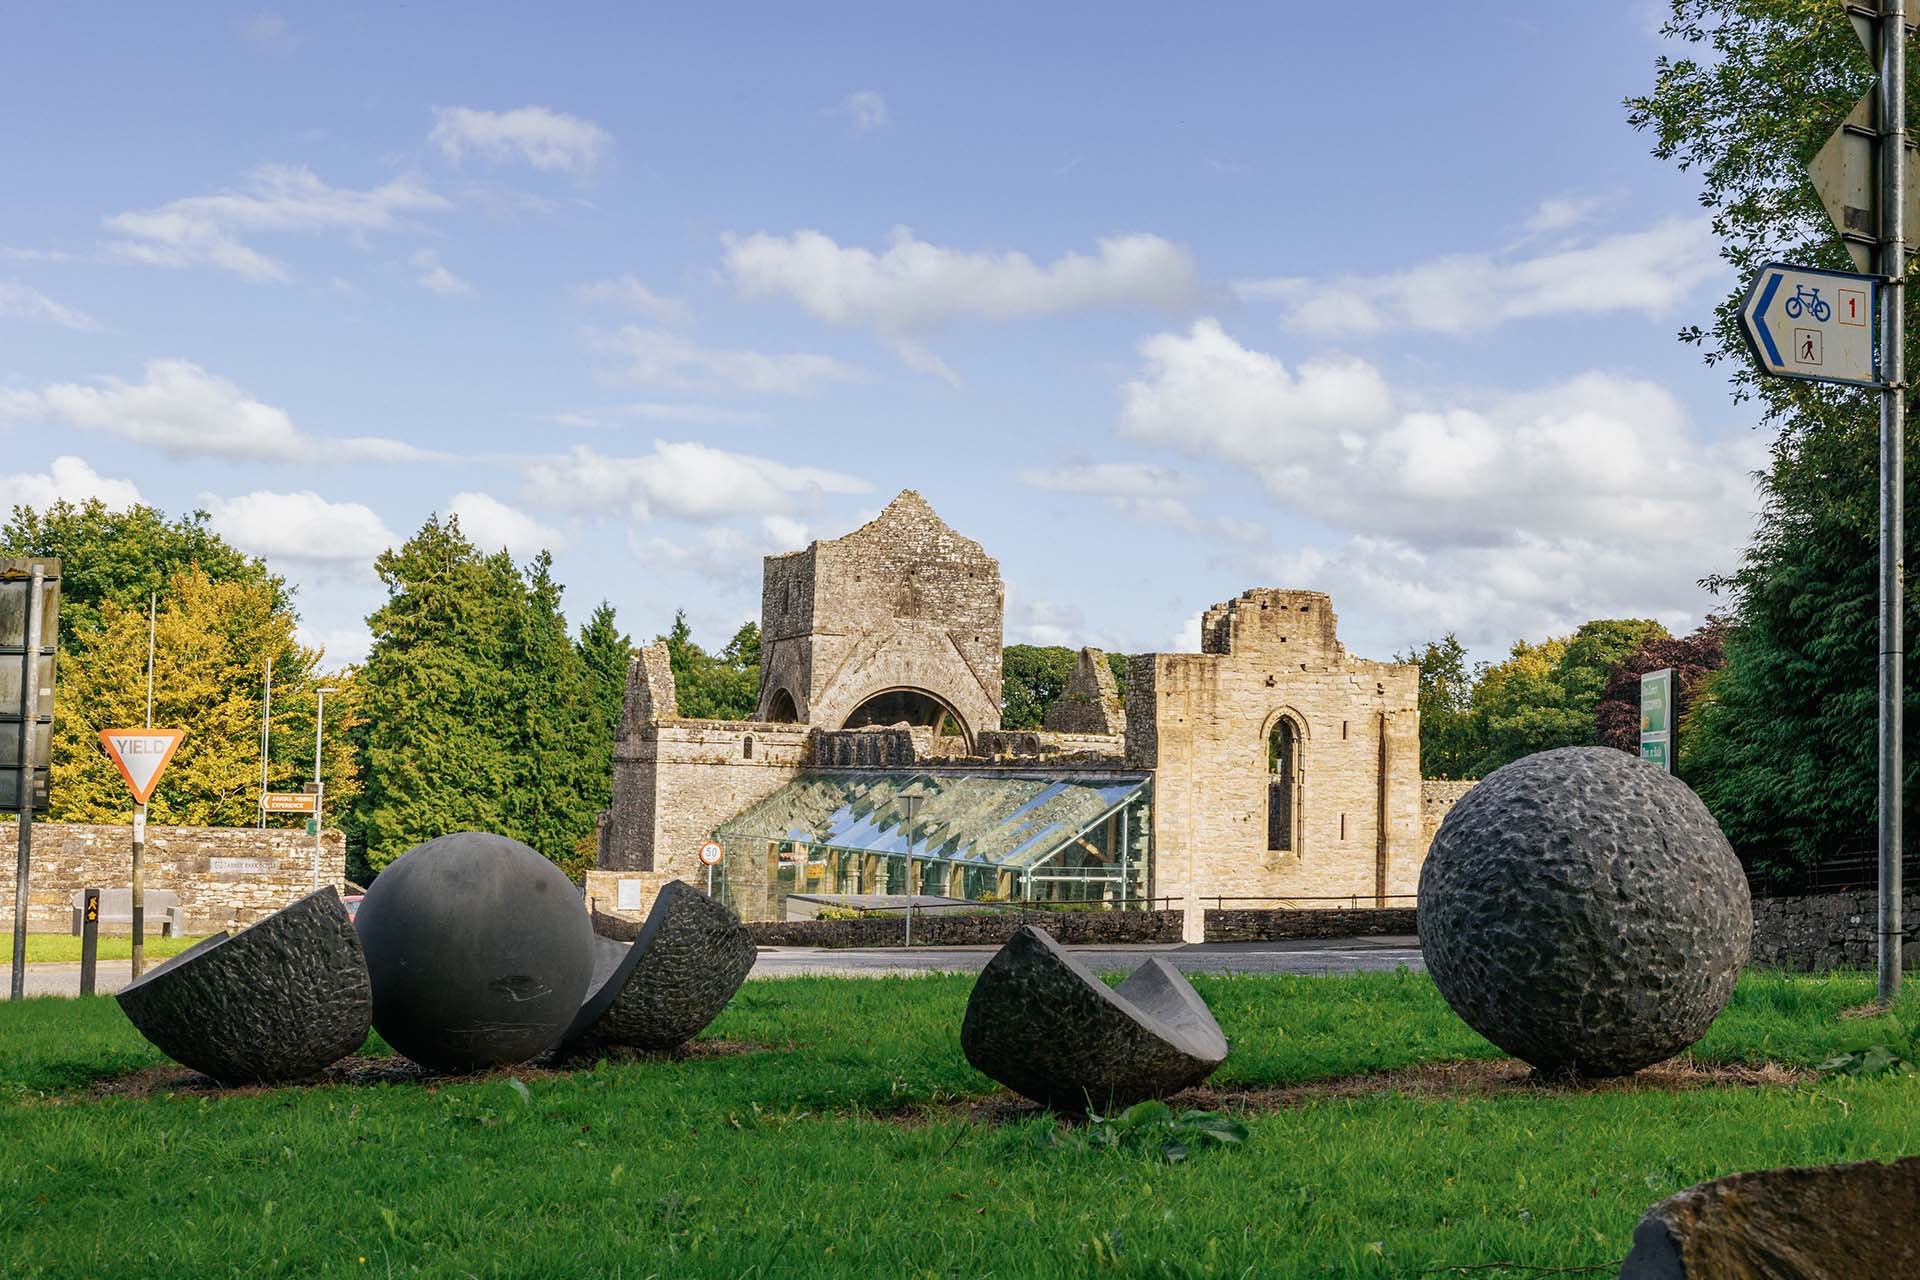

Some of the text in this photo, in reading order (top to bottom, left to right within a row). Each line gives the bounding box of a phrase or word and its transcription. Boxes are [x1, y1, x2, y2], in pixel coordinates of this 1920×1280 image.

[1849, 298, 1855, 318] 1
[116, 739, 165, 754] YIELD
[706, 847, 717, 857] 50
